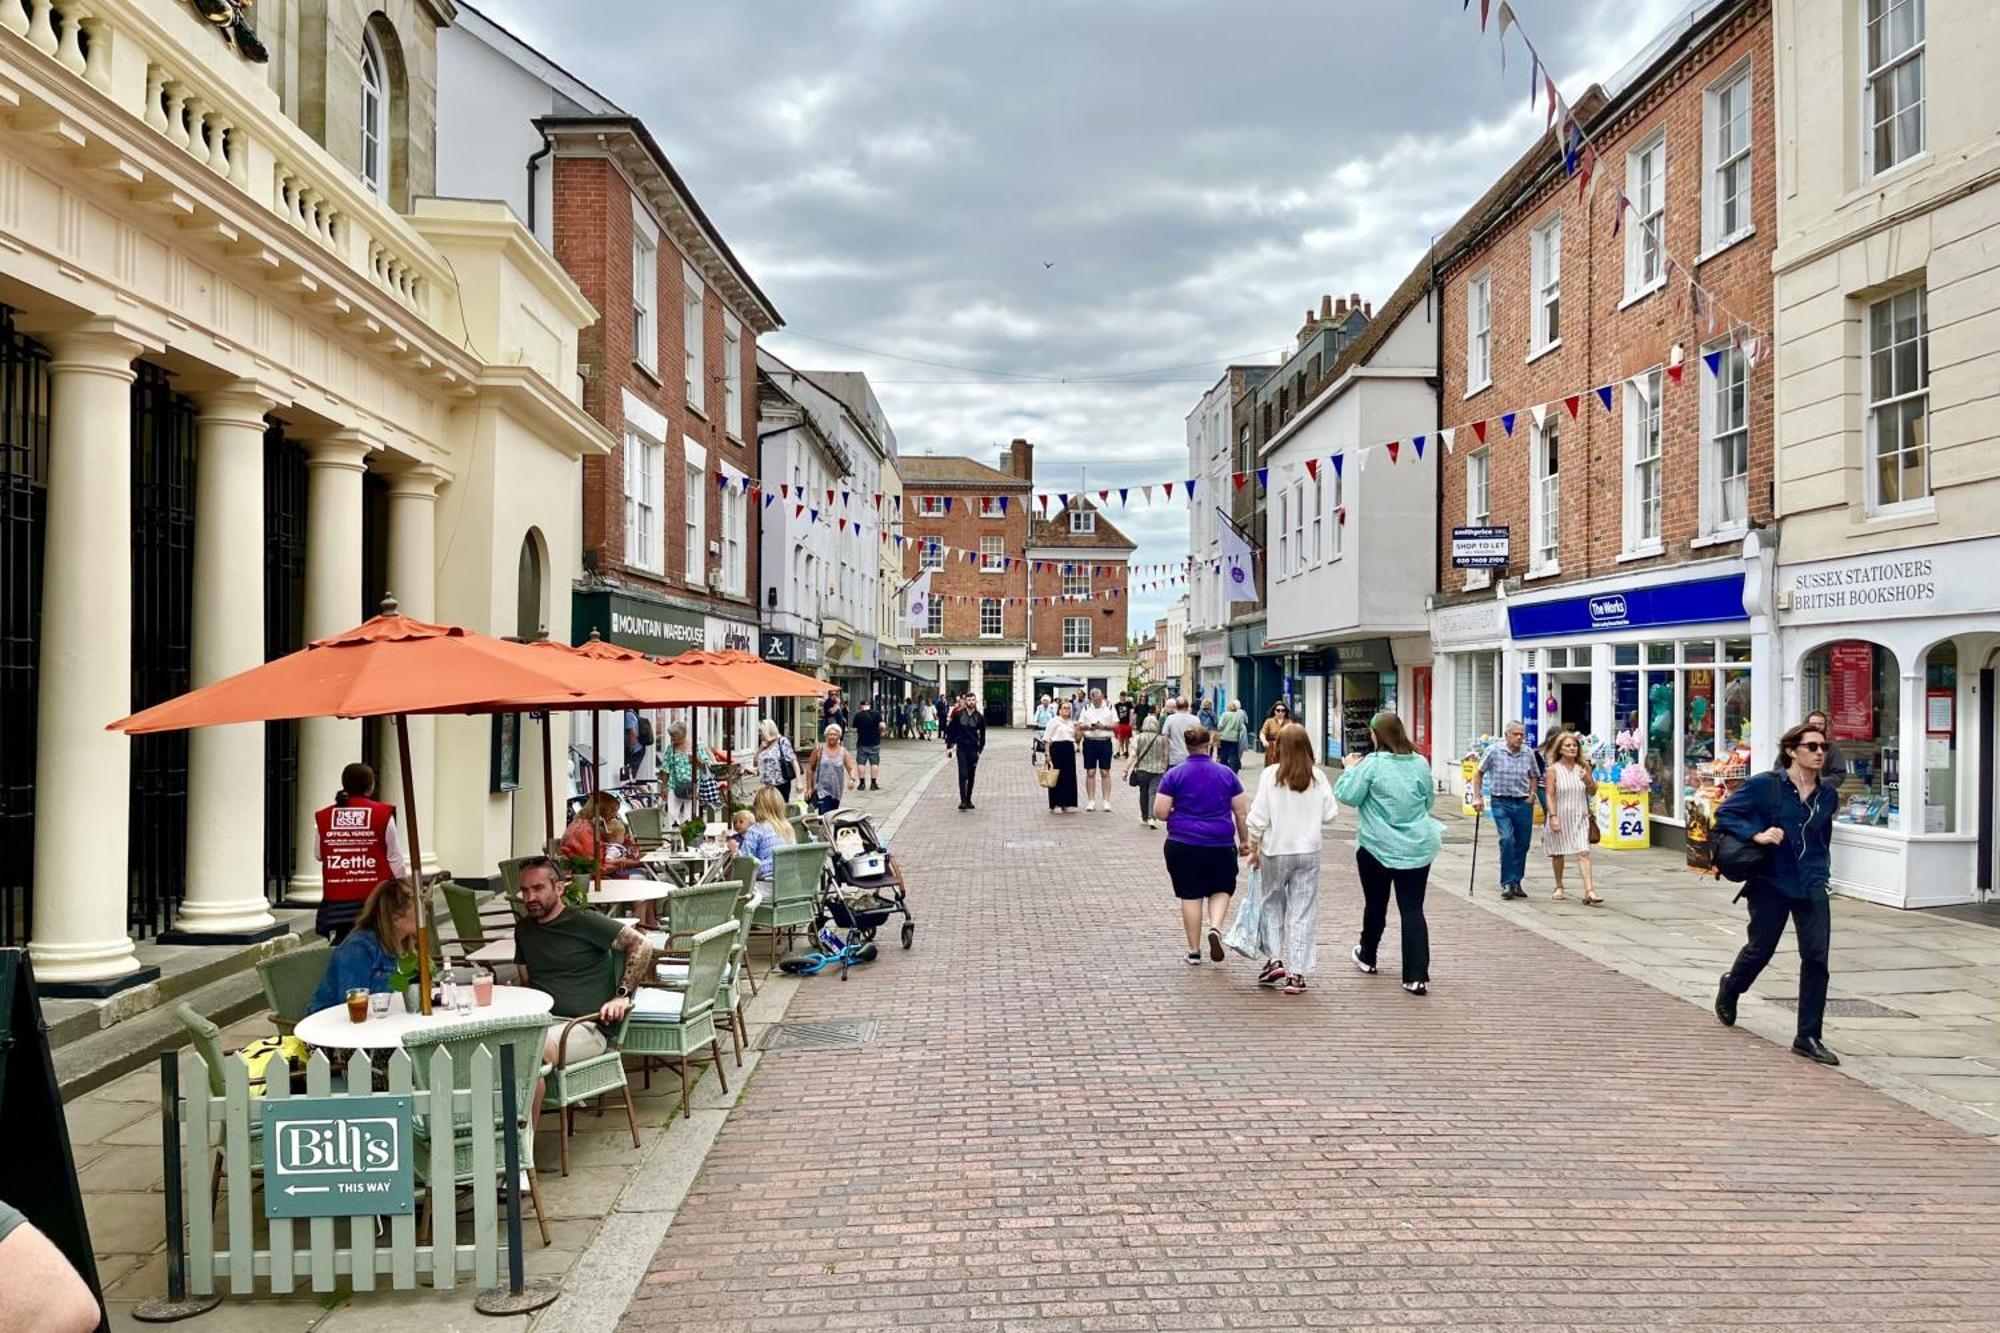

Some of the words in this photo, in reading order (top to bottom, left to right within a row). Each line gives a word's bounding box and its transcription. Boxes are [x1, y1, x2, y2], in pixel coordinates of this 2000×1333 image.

[1796, 570, 1842, 590] SUSSEX
[1845, 559, 1932, 584] STATIONERS
[1795, 591, 1845, 610] BRITISH
[1850, 582, 1934, 606] BOOKSHOPS
[1592, 603, 1604, 616] The
[1603, 600, 1624, 614] Works
[619, 615, 662, 638] MOUNTAIN
[663, 622, 704, 643] WAREHOUSE
[336, 817, 365, 825] ISSUE
[1620, 820, 1643, 836] £4
[327, 855, 376, 869] iZettle
[288, 1119, 389, 1172] Bill's
[338, 1183, 364, 1193] THIS
[366, 1182, 391, 1193] WAY
